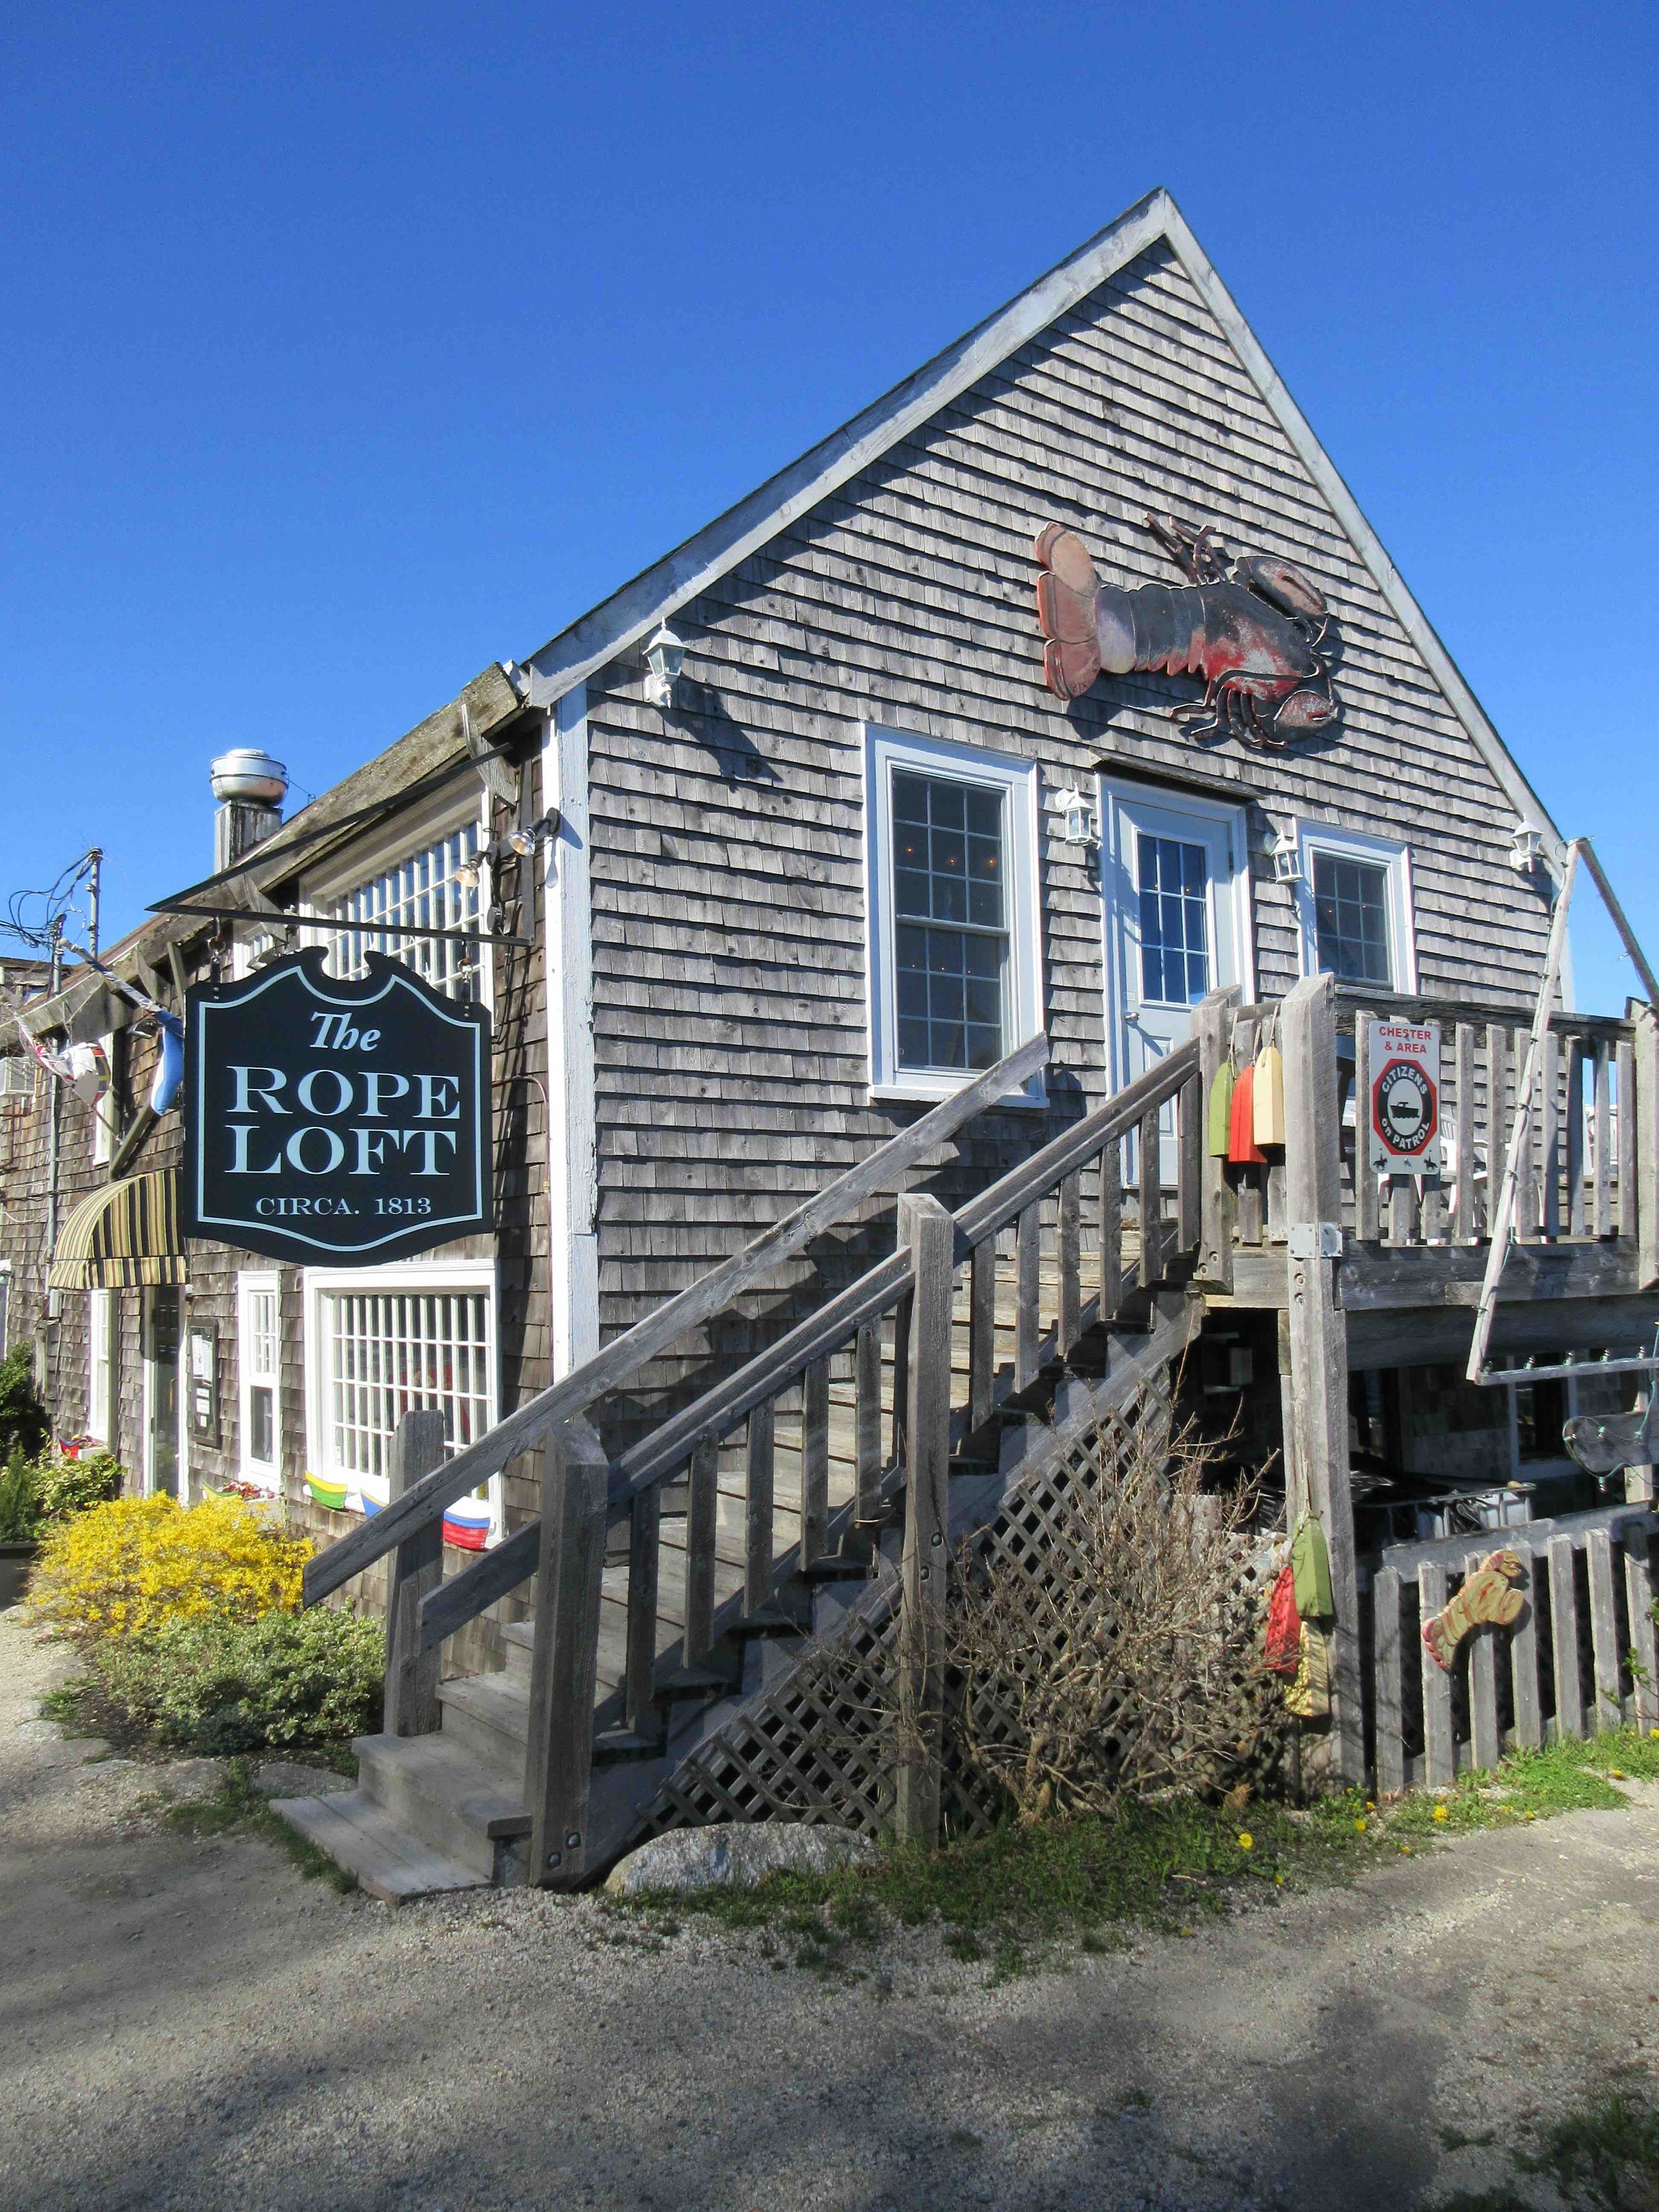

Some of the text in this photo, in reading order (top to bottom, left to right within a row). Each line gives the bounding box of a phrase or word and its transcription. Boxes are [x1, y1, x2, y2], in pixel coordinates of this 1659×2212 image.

[311, 1011, 381, 1051] The
[1379, 1026, 1431, 1040] CHESTER
[1384, 1041, 1427, 1054] & AREA
[226, 1066, 460, 1119] ROPE
[1382, 1066, 1427, 1094] CITIZENS
[1393, 1122, 1429, 1149] PATROL
[224, 1125, 456, 1175] LOFT
[255, 1197, 431, 1215] CIRCA. 1813
